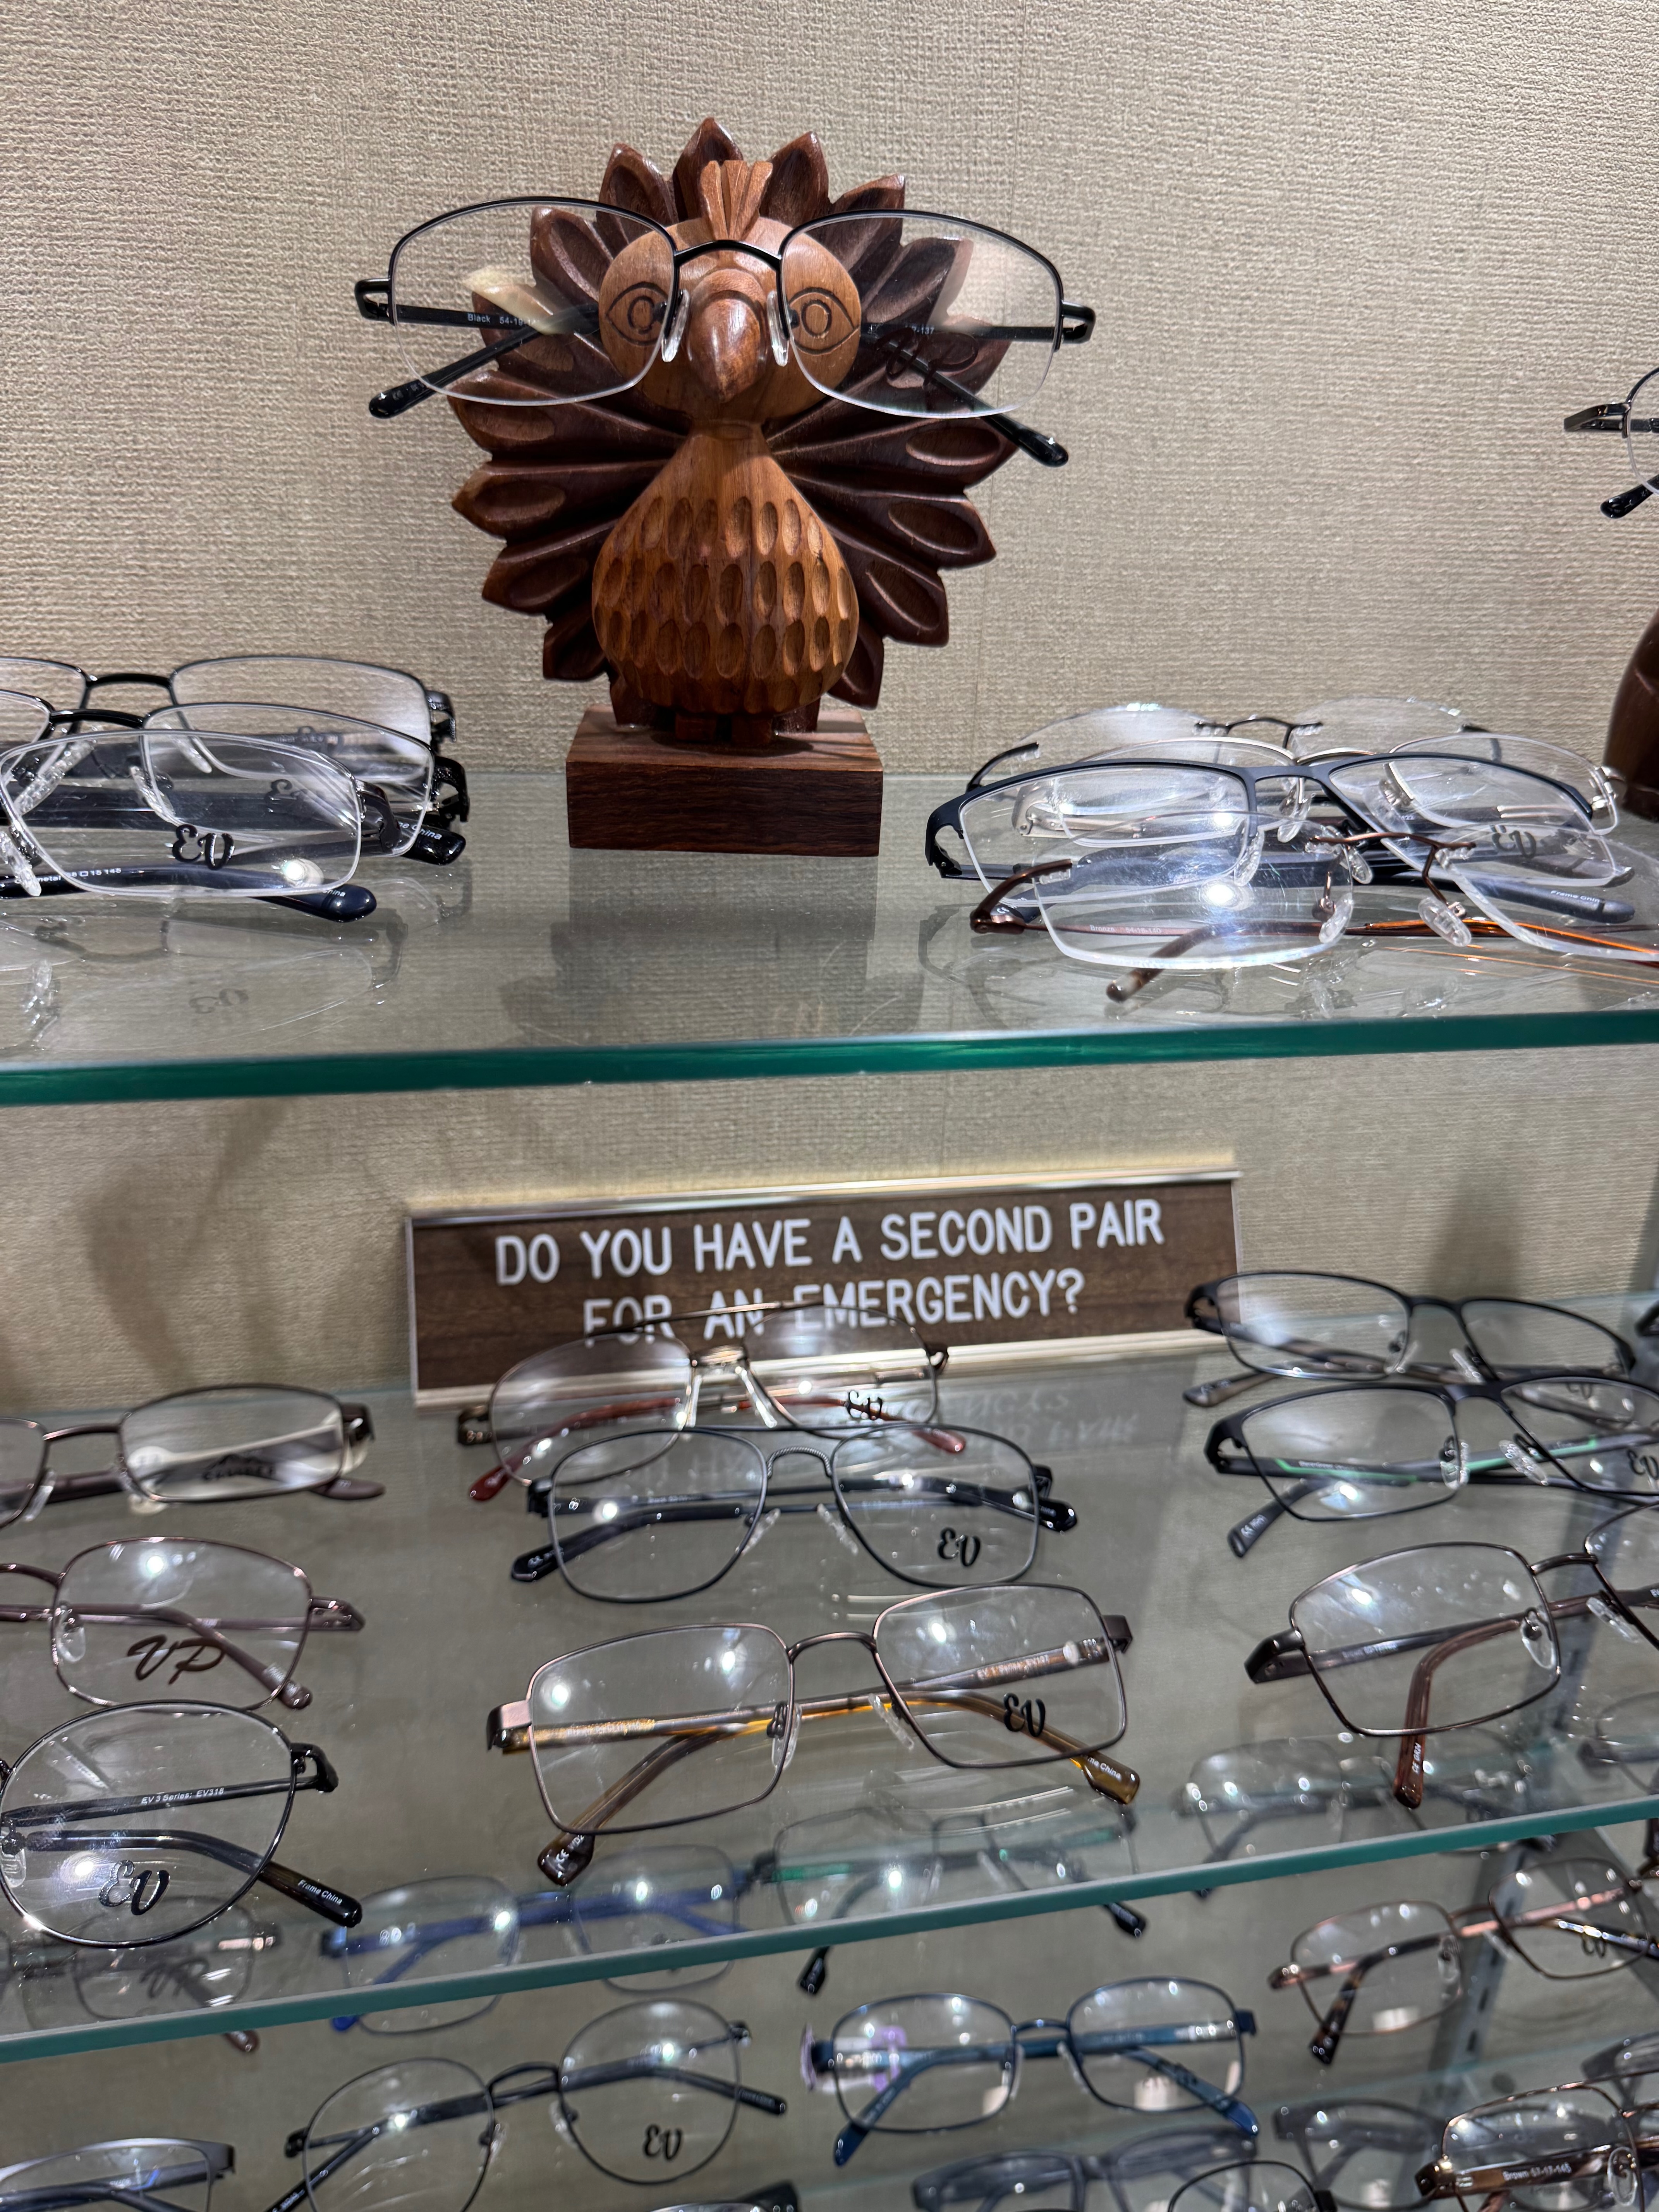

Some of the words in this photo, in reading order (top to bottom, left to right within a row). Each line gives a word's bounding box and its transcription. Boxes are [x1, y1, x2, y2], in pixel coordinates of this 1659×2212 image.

[467, 313, 491, 323] Black
[172, 824, 235, 870] EV
[411, 824, 442, 840] China
[496, 1233, 560, 1286] DO
[580, 1226, 673, 1279] YOU
[694, 1218, 813, 1273] HAVE
[832, 1216, 863, 1264] A
[880, 1205, 1053, 1261] SECOND
[1070, 1199, 1165, 1250] PAIR
[583, 1295, 676, 1348] FOR
[703, 1288, 765, 1341] AN
[793, 1267, 1085, 1331] EMERGENCY?
[937, 1527, 981, 1567] EV
[127, 1634, 227, 1685] VP
[1003, 1693, 1046, 1737] EV
[1100, 1763, 1121, 1781] China
[141, 1796, 154, 1805] EV
[163, 1793, 193, 1801] Series:
[196, 1787, 224, 1797] EV318
[99, 1860, 171, 1915] EV
[298, 1879, 321, 1895] Frame
[321, 1890, 343, 1905] China
[644, 2124, 683, 2160] EV
